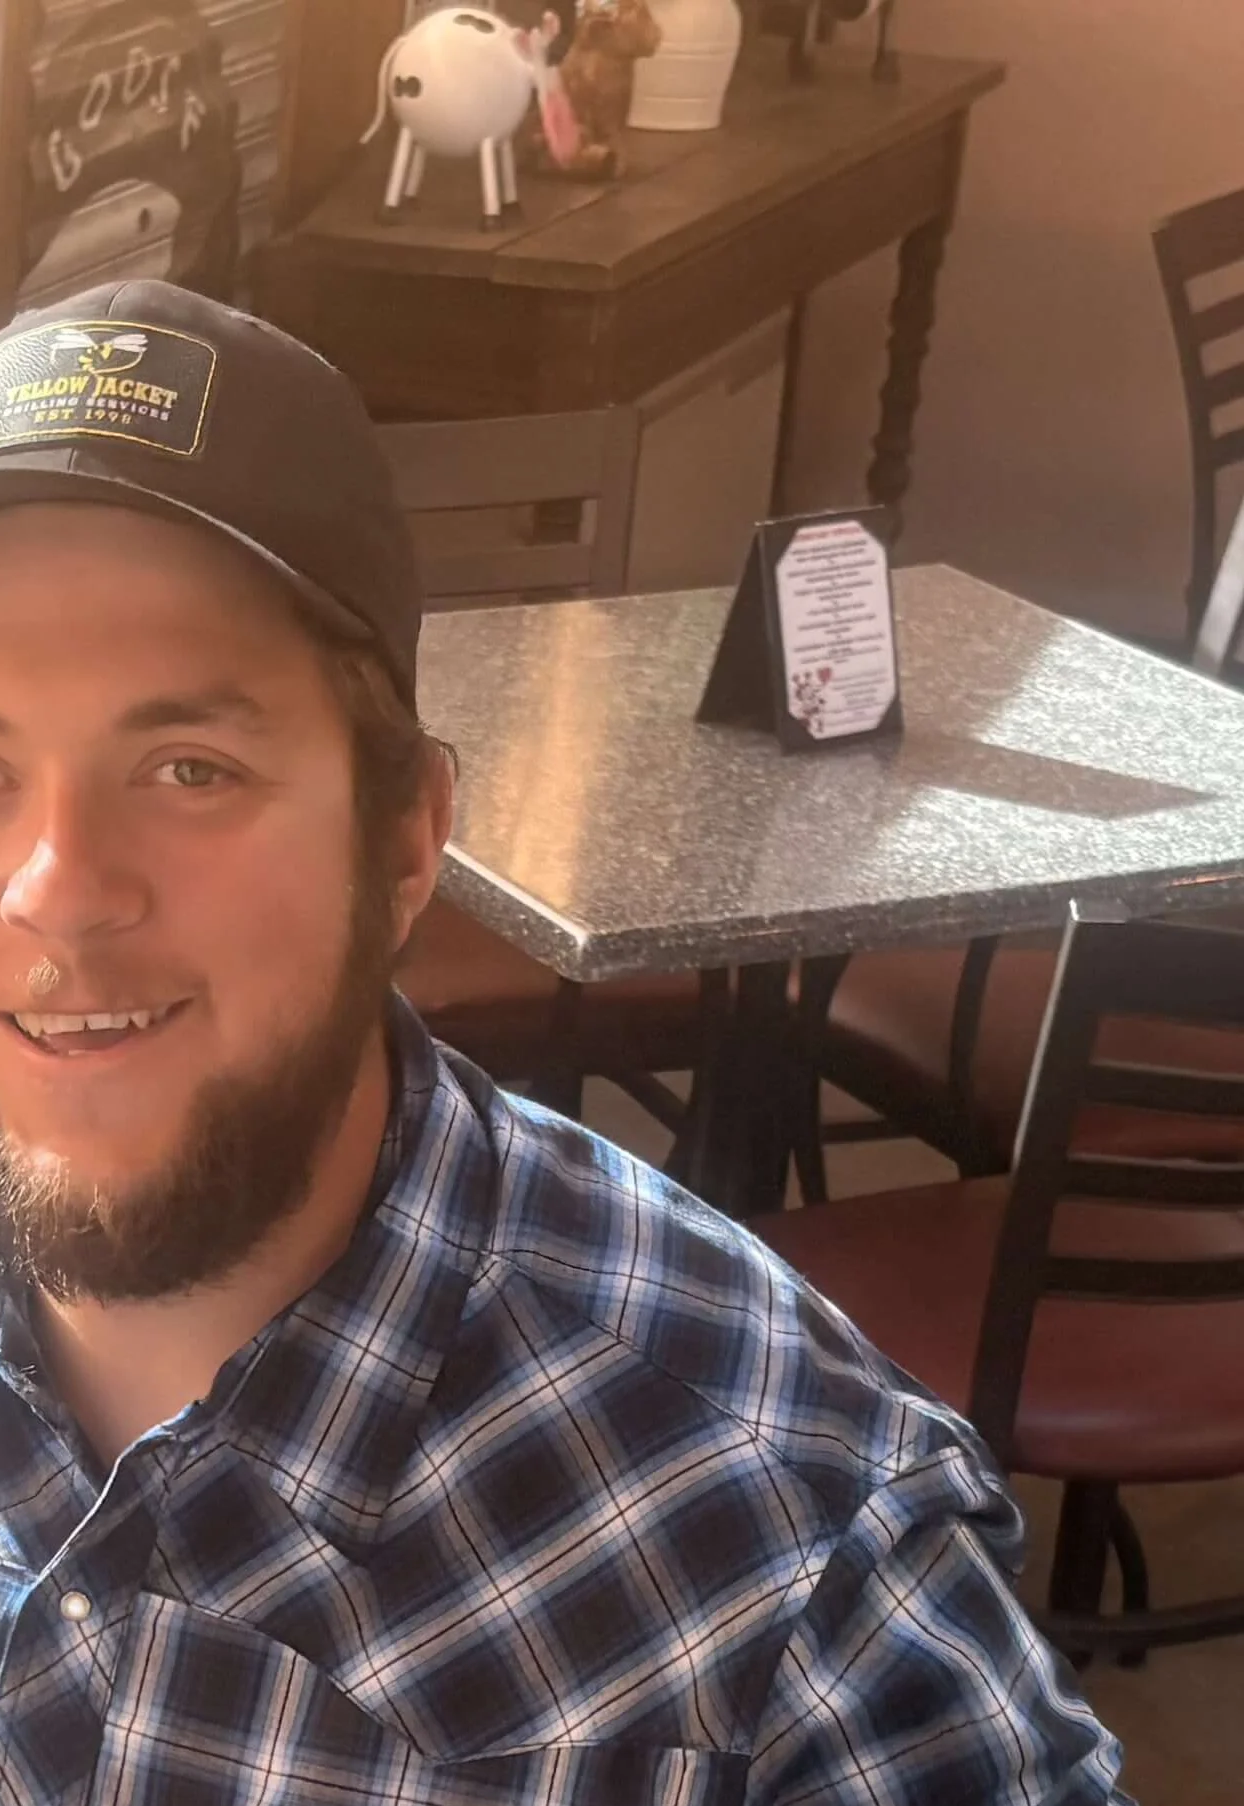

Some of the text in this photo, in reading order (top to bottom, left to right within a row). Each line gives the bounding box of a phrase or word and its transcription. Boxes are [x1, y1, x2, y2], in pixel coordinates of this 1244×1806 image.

[6, 375, 179, 408] YELLOW JACKET
[85, 396, 170, 422] SERVICES
